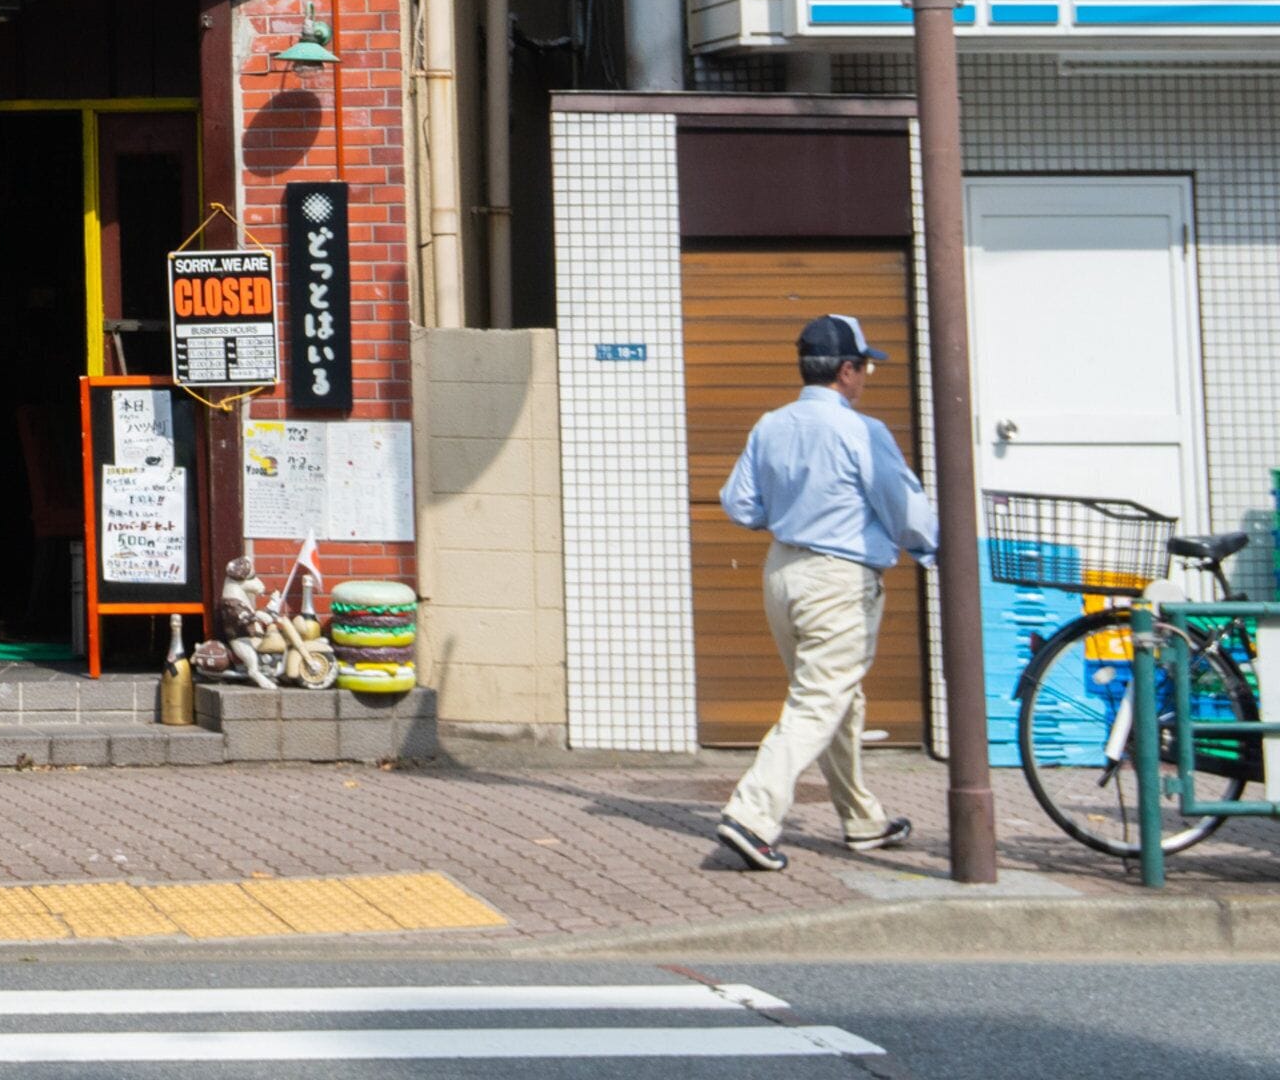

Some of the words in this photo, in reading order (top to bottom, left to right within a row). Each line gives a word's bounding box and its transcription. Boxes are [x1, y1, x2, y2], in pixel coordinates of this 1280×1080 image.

[243, 257, 269, 271] ARE
[174, 276, 272, 317] CLOSED
[304, 225, 336, 396] どっとはいる
[191, 326, 229, 335] BUSINESS
[230, 325, 258, 334] HOURS
